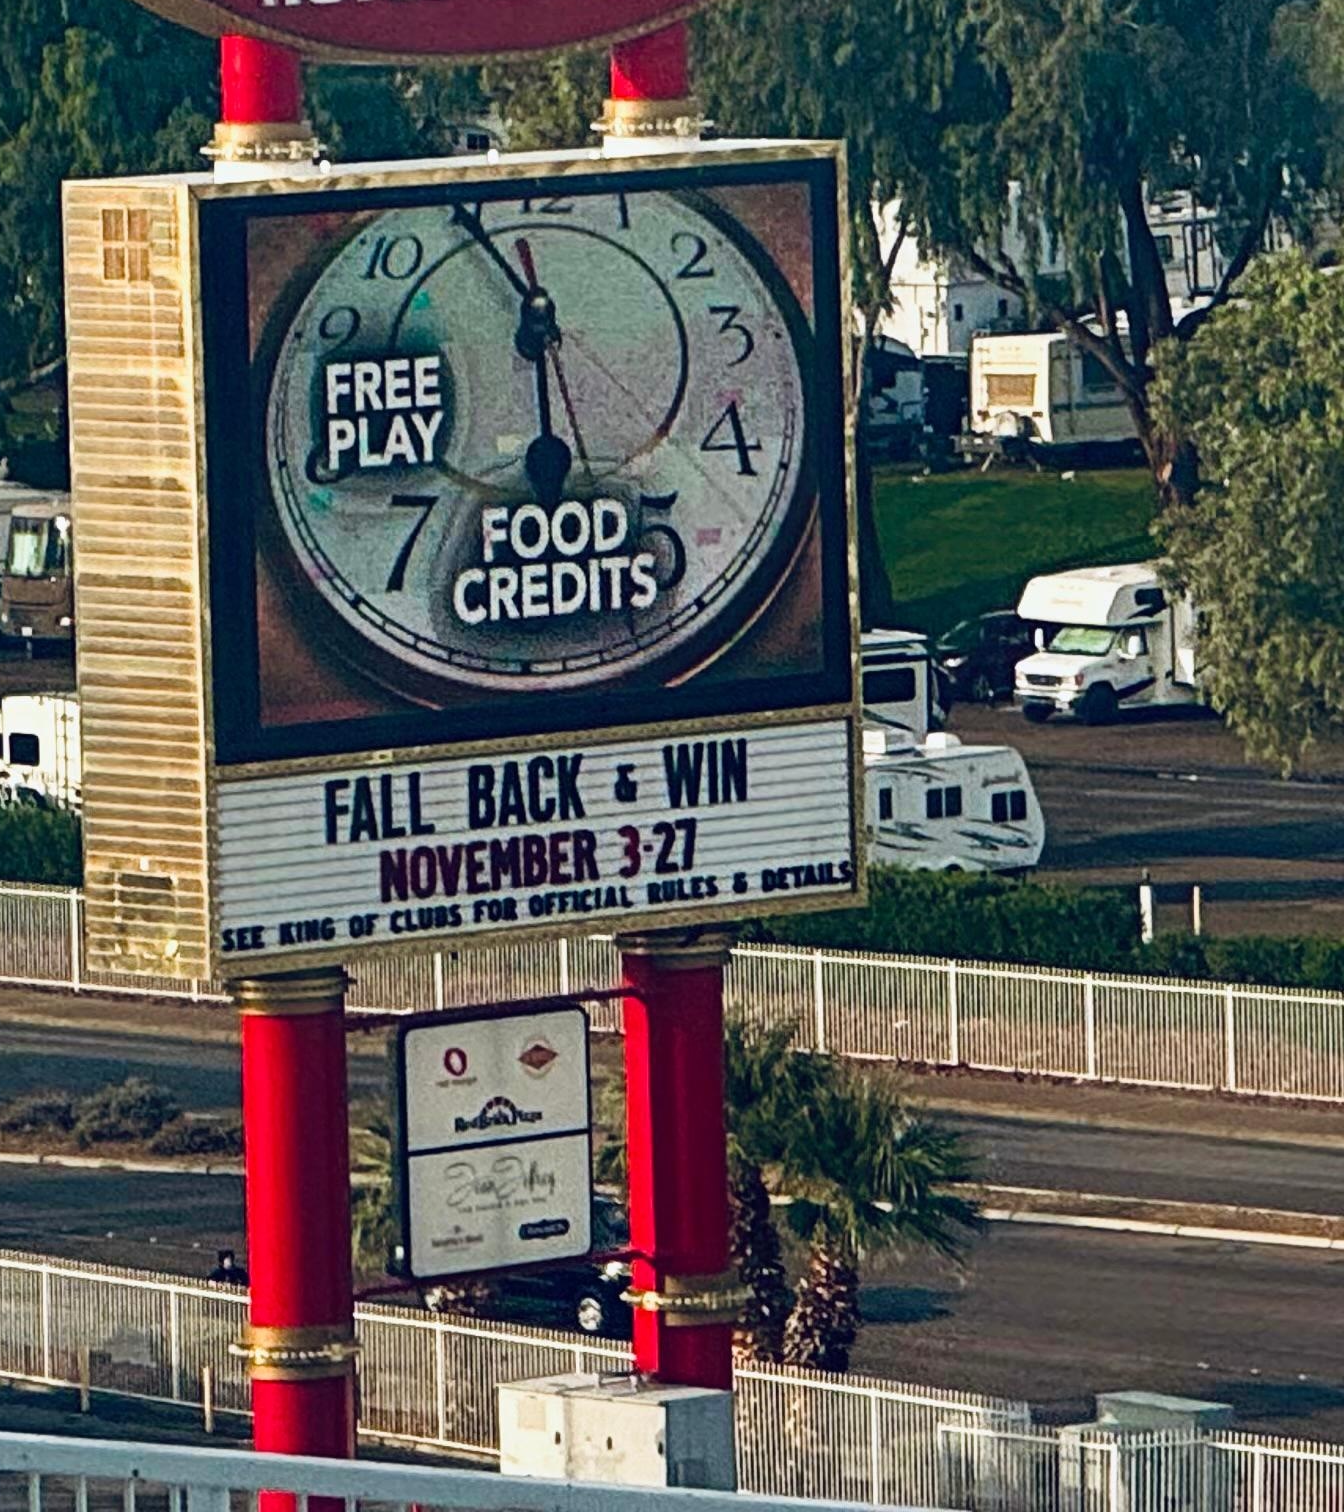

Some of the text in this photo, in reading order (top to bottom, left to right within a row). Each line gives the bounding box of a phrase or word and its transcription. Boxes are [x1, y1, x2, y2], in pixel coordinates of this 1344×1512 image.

[361, 235, 424, 281] 10
[670, 233, 715, 279] 2
[318, 306, 361, 352] 9
[708, 305, 755, 367] 3
[326, 355, 442, 415] FREE
[328, 410, 444, 471] PLAY
[699, 400, 762, 476] 4
[389, 493, 439, 592] 7
[482, 498, 629, 563] FOOD
[452, 552, 658, 625] CREDITS
[324, 738, 750, 845] FALL BACK & WIN
[379, 817, 699, 903] NOVEMBER 3-27
[221, 860, 854, 952] SEE KING OF CLUBS FOR OFFICIAL RULES & DETAILS
